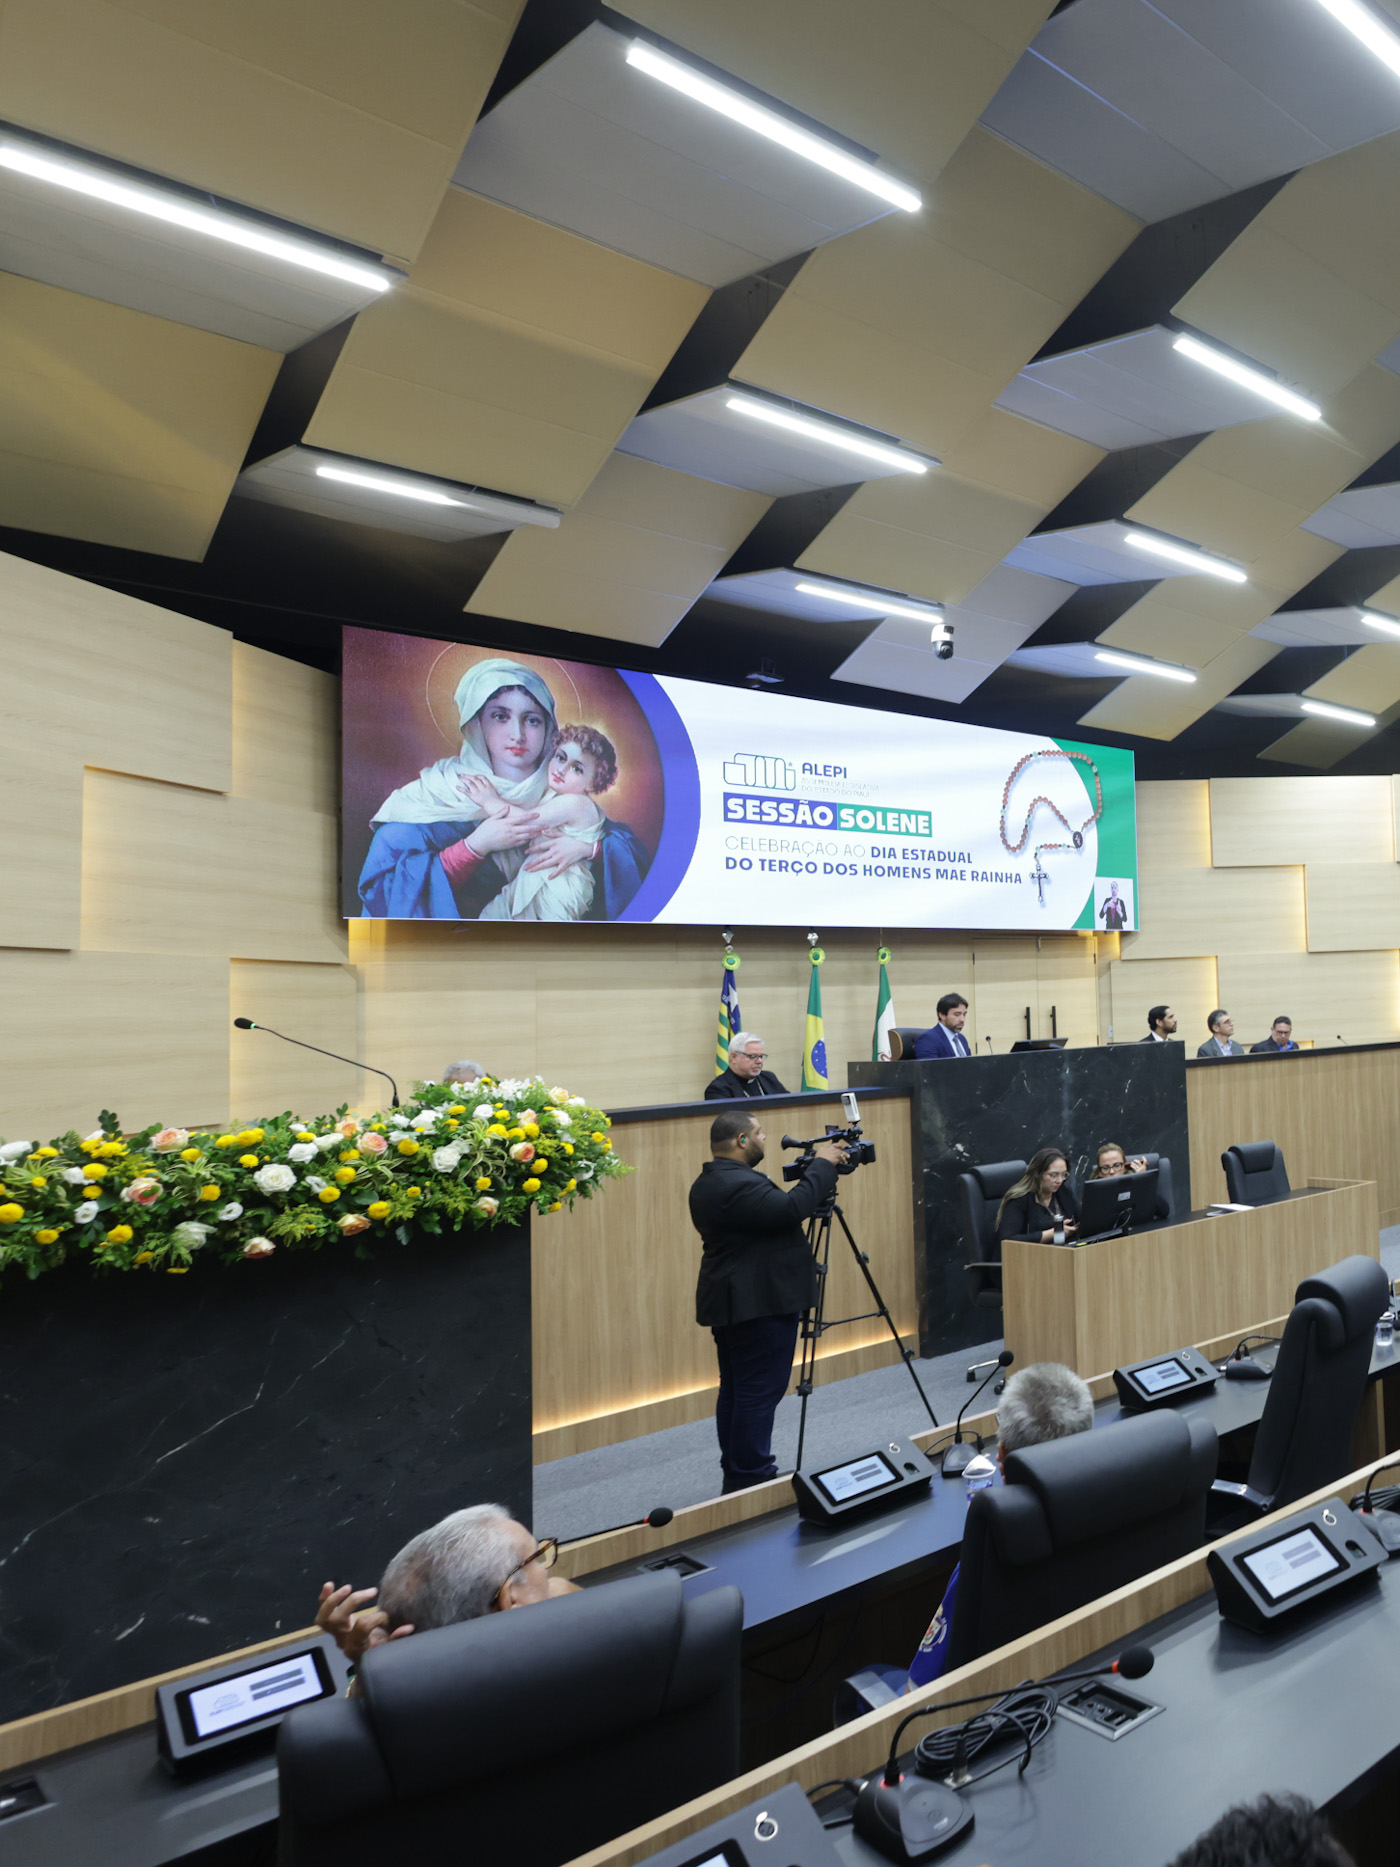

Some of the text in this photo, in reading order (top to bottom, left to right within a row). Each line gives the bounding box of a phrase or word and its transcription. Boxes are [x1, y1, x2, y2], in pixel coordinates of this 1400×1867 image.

[802, 762, 848, 779] ALEPI
[727, 797, 930, 835] SESSÃO SOLENE
[725, 835, 973, 864] CELEBRAÇÃO AO DIA ESTADUAL
[725, 856, 753, 871] DO
[759, 858, 818, 877] TERÇO
[823, 862, 858, 876] DOS
[863, 864, 931, 879] HOMENS
[971, 870, 1022, 884] RAINHA
